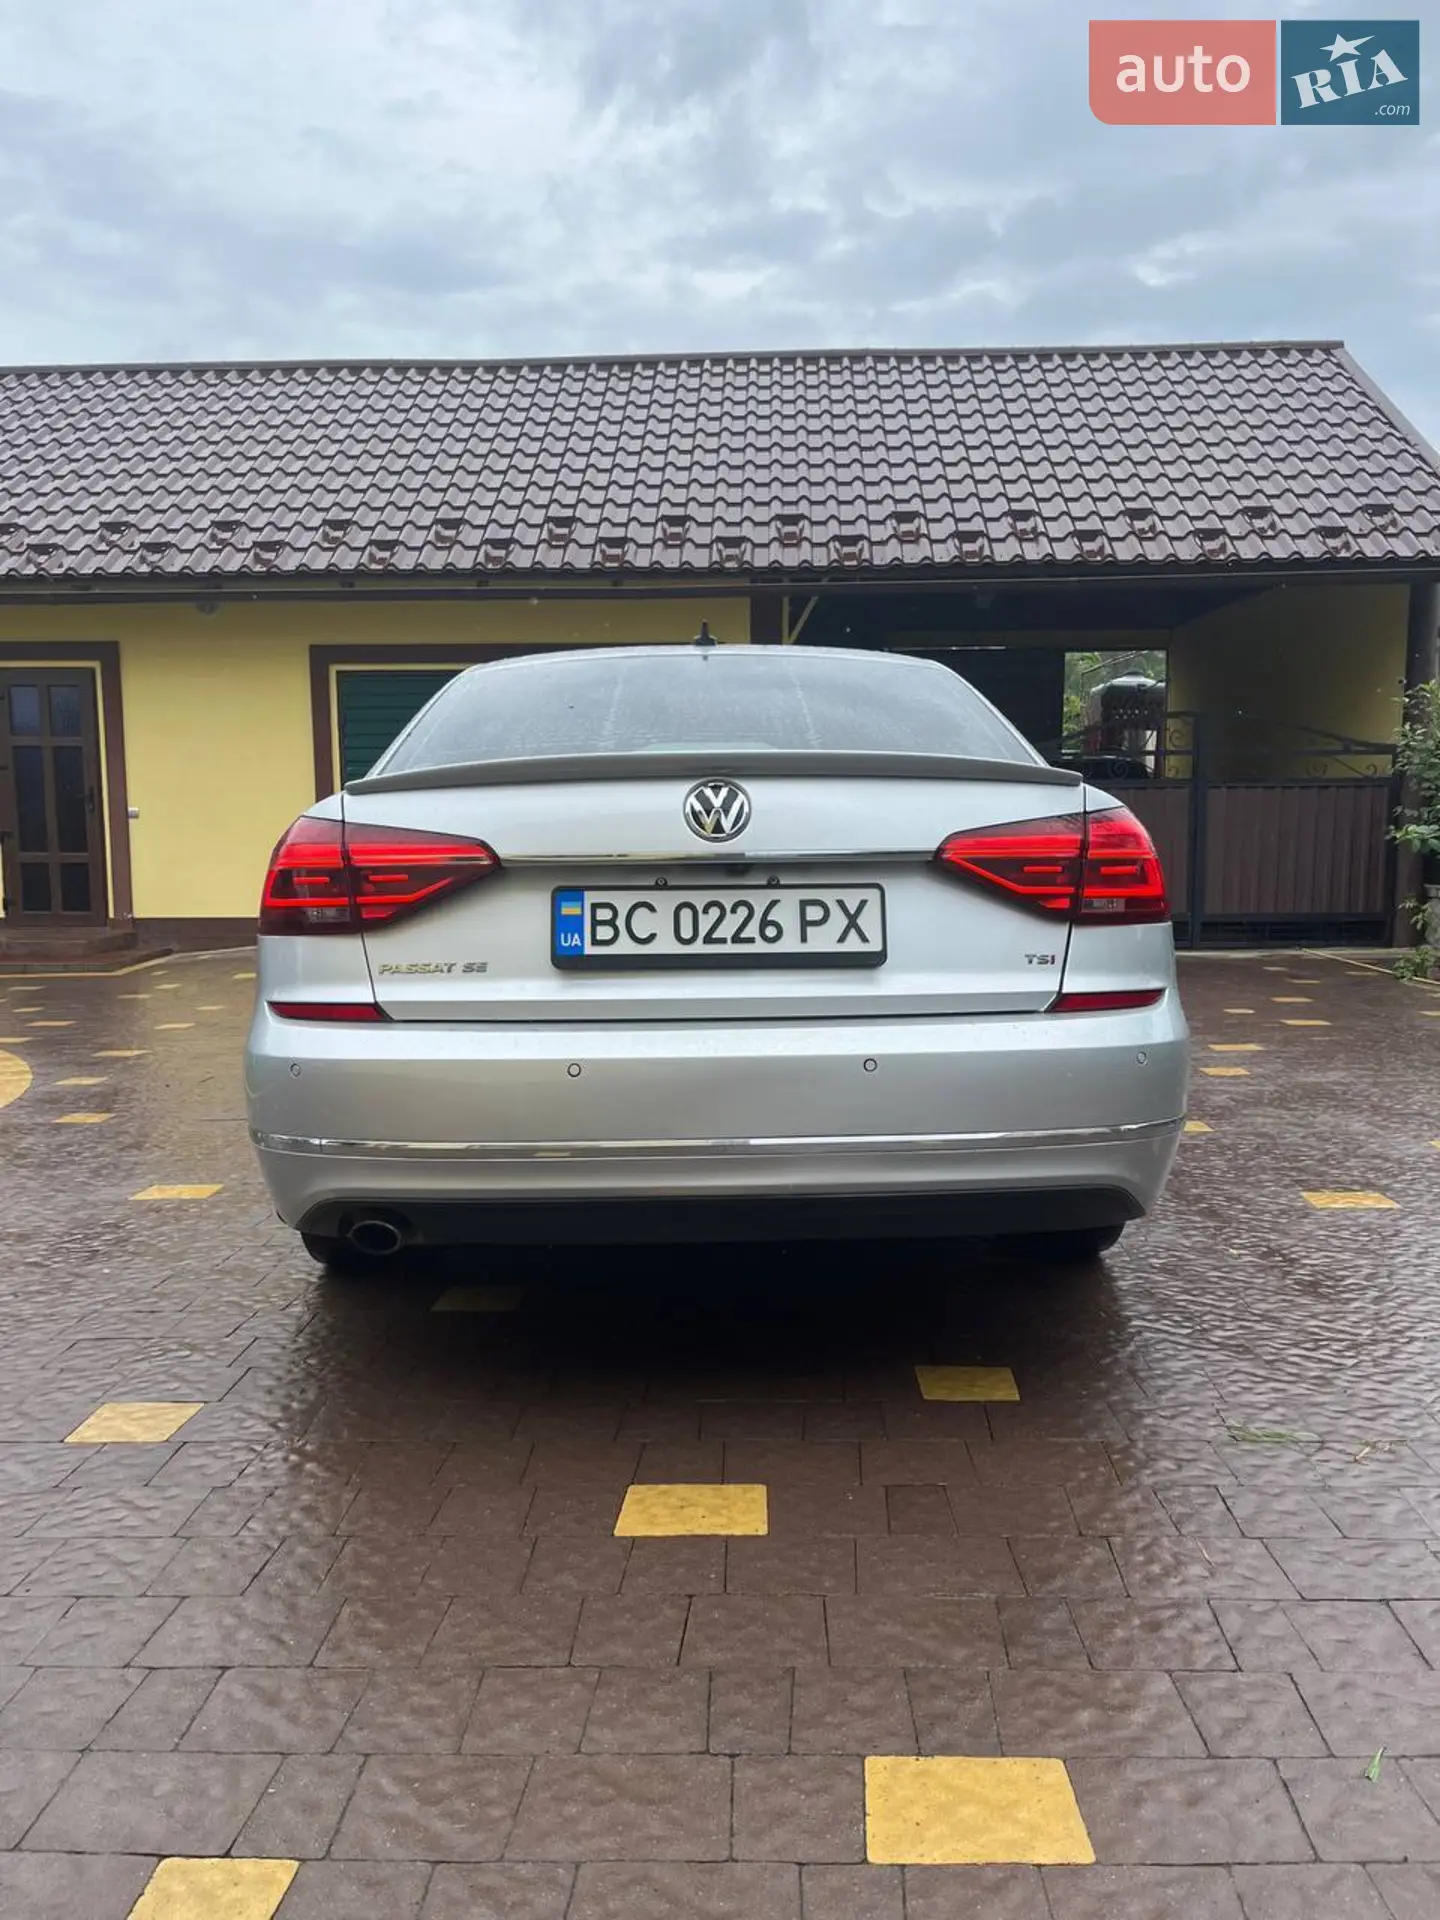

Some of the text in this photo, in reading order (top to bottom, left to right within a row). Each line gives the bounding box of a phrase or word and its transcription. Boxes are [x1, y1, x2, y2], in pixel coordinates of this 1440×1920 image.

[590, 898, 870, 946] BC 0226 PX
[560, 933, 582, 947] UA
[1024, 954, 1055, 965] TSI
[379, 962, 488, 975] PASSAT SE
